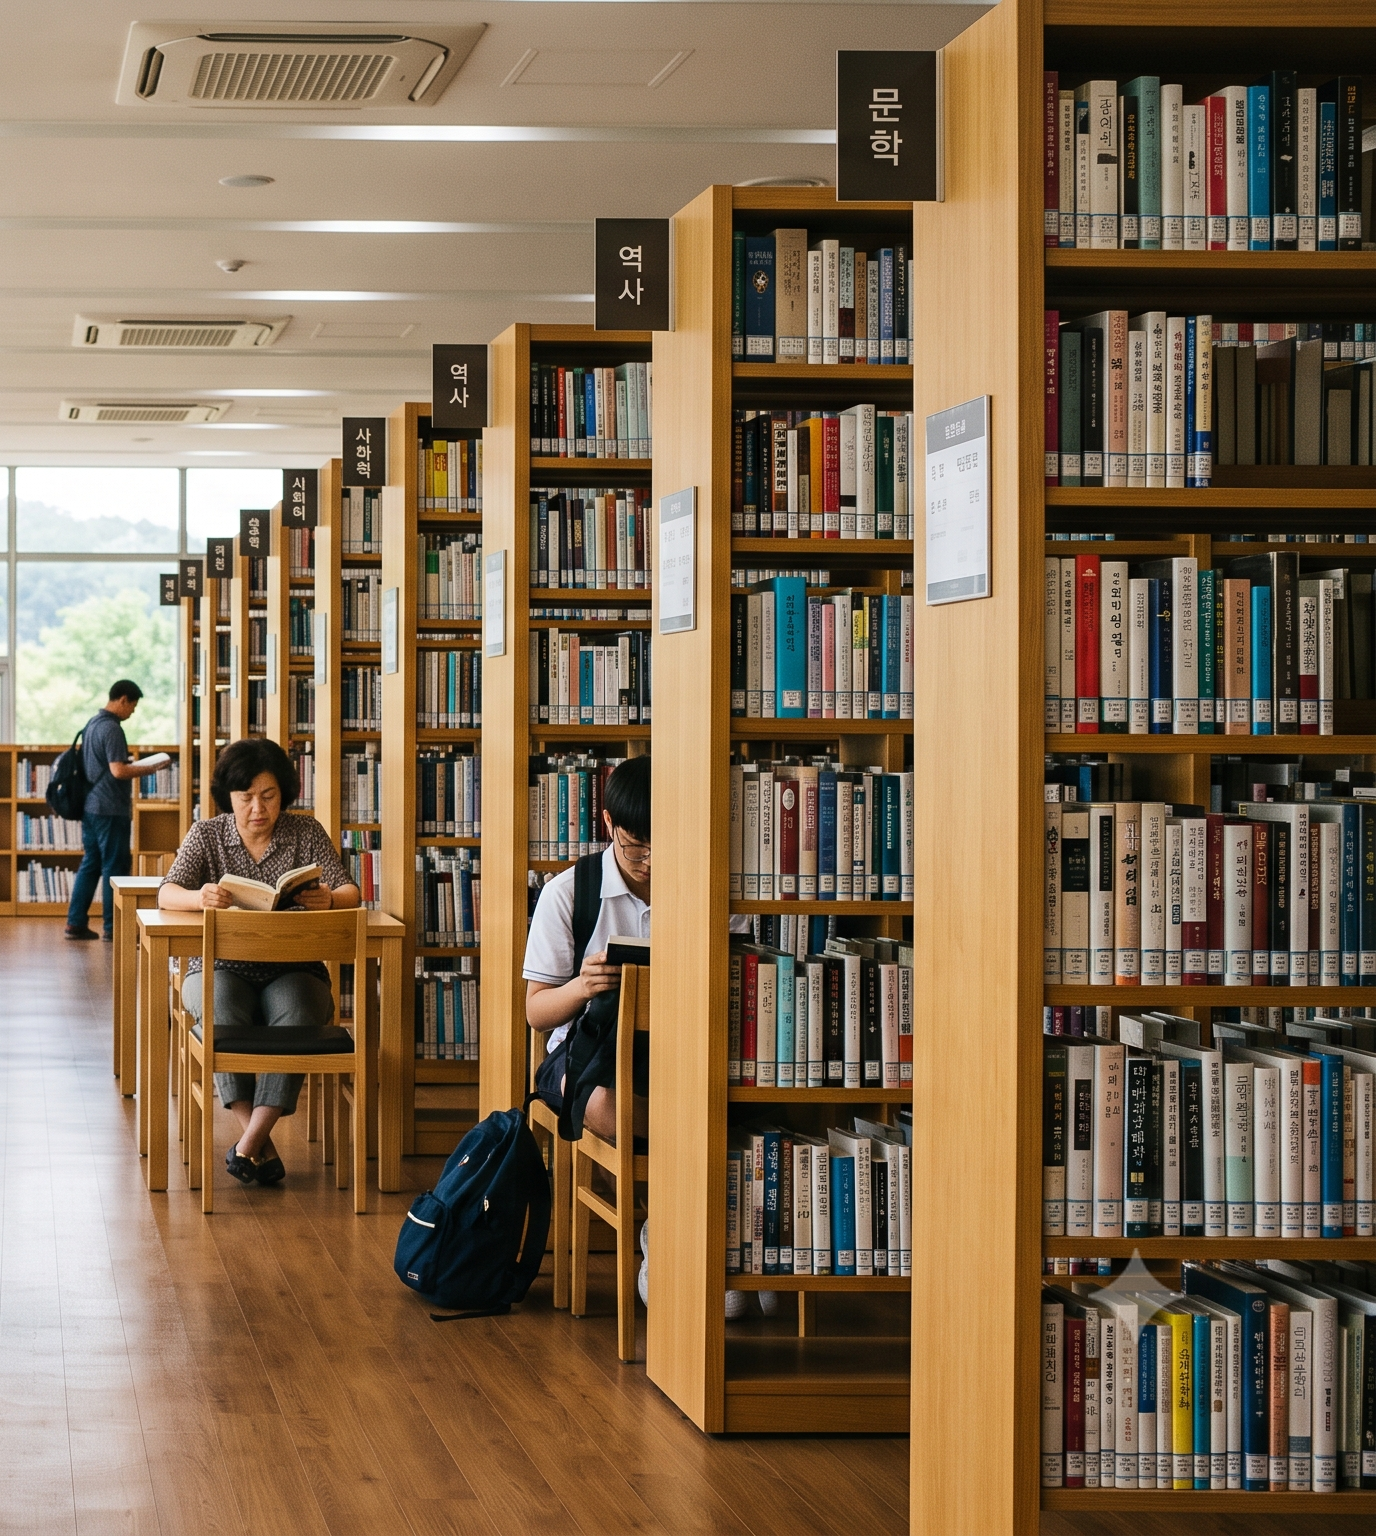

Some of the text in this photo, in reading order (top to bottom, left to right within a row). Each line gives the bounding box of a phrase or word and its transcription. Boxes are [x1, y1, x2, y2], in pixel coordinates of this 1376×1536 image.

[869, 88, 903, 167] 문학
[617, 245, 645, 306] 역사
[450, 363, 470, 408] 역사
